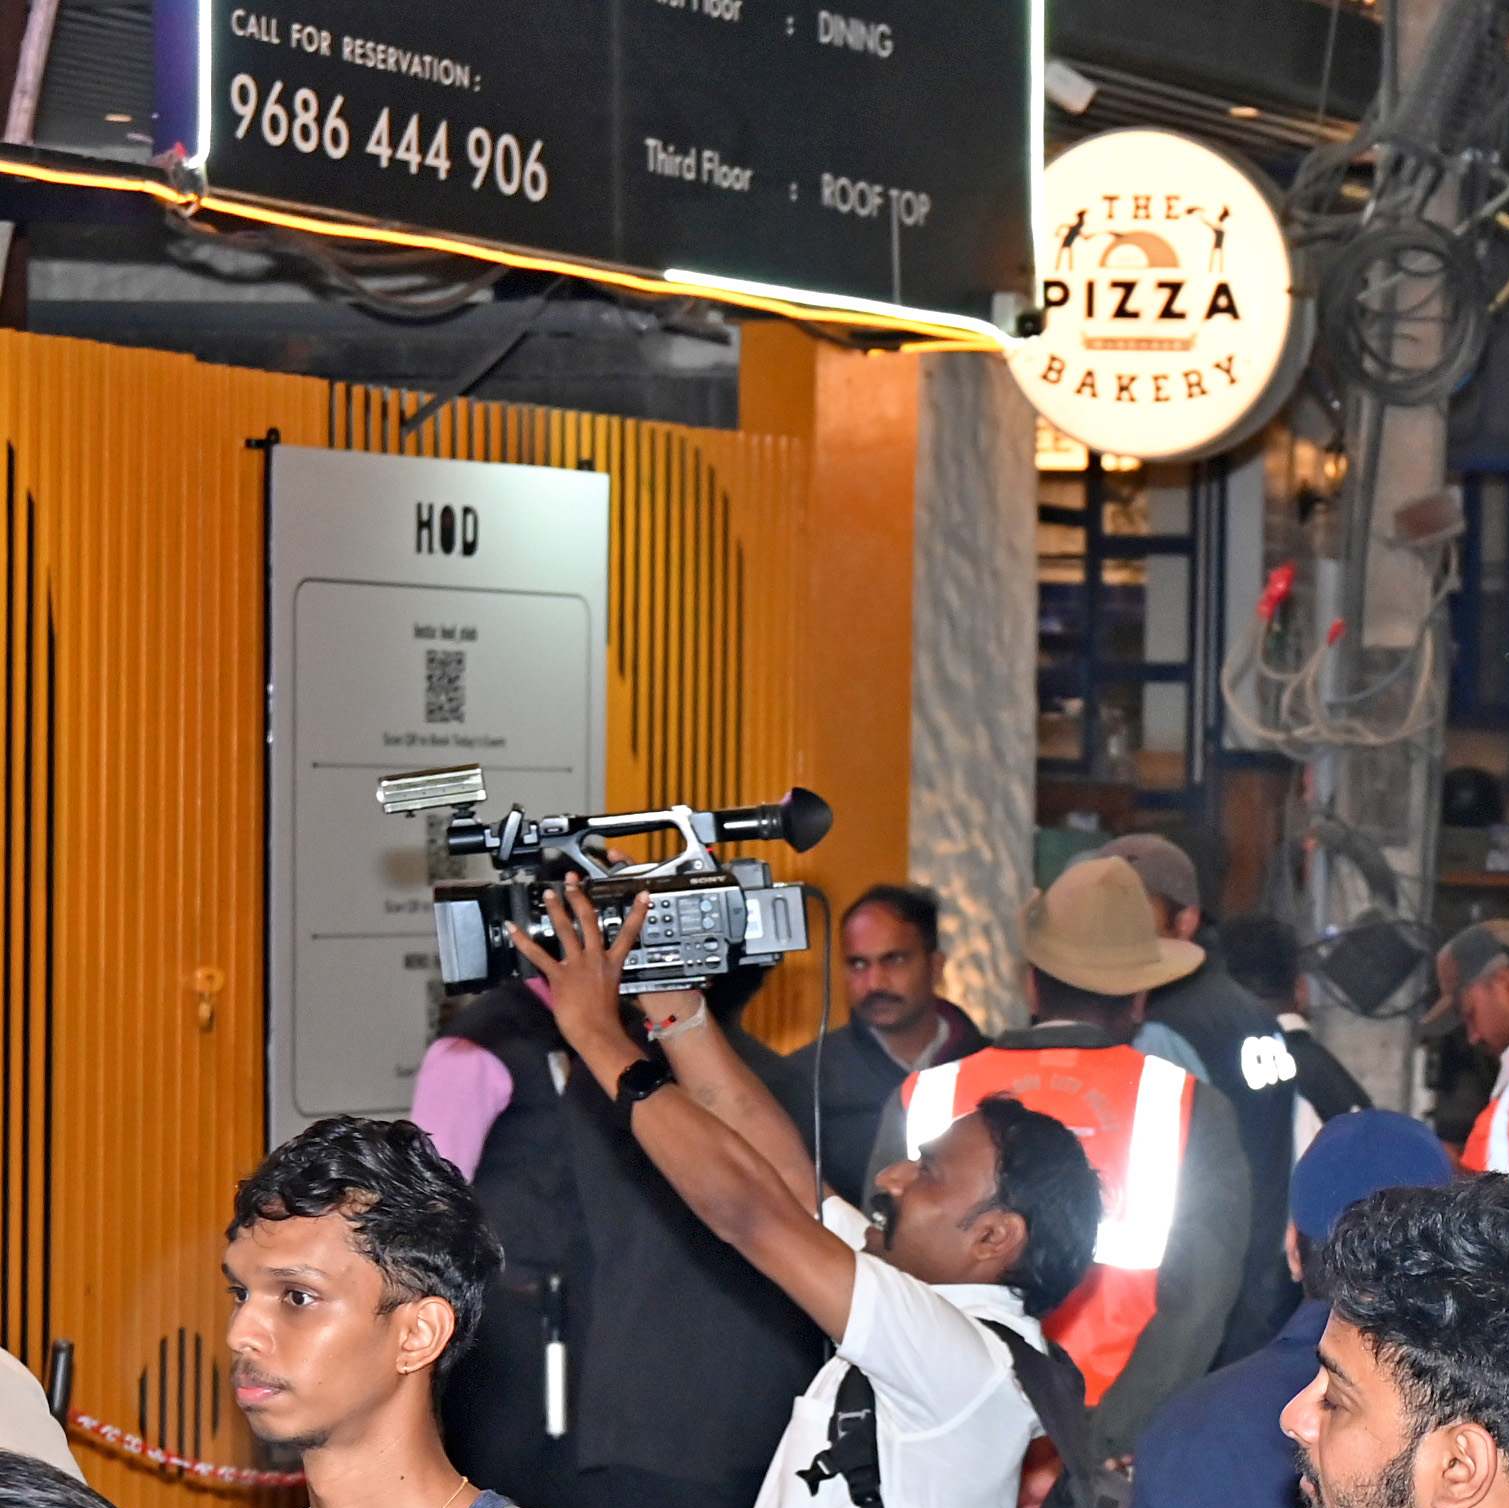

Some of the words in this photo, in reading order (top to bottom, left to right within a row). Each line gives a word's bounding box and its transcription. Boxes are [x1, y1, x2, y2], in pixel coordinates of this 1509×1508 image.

[231, 8, 281, 45] CALL
[290, 23, 332, 57] FOR
[817, 9, 895, 59] DINING
[230, 73, 350, 160] 9686
[366, 106, 452, 181] 444
[466, 126, 549, 202] 906
[644, 137, 697, 181] Third
[702, 149, 754, 192] Floor
[820, 172, 884, 217] ROOF
[888, 187, 932, 227] TOP
[1102, 195, 1181, 220] THE
[1043, 280, 1241, 320] PIZZA
[1041, 354, 1239, 402] BAKERY
[690, 875, 727, 885] SONY
